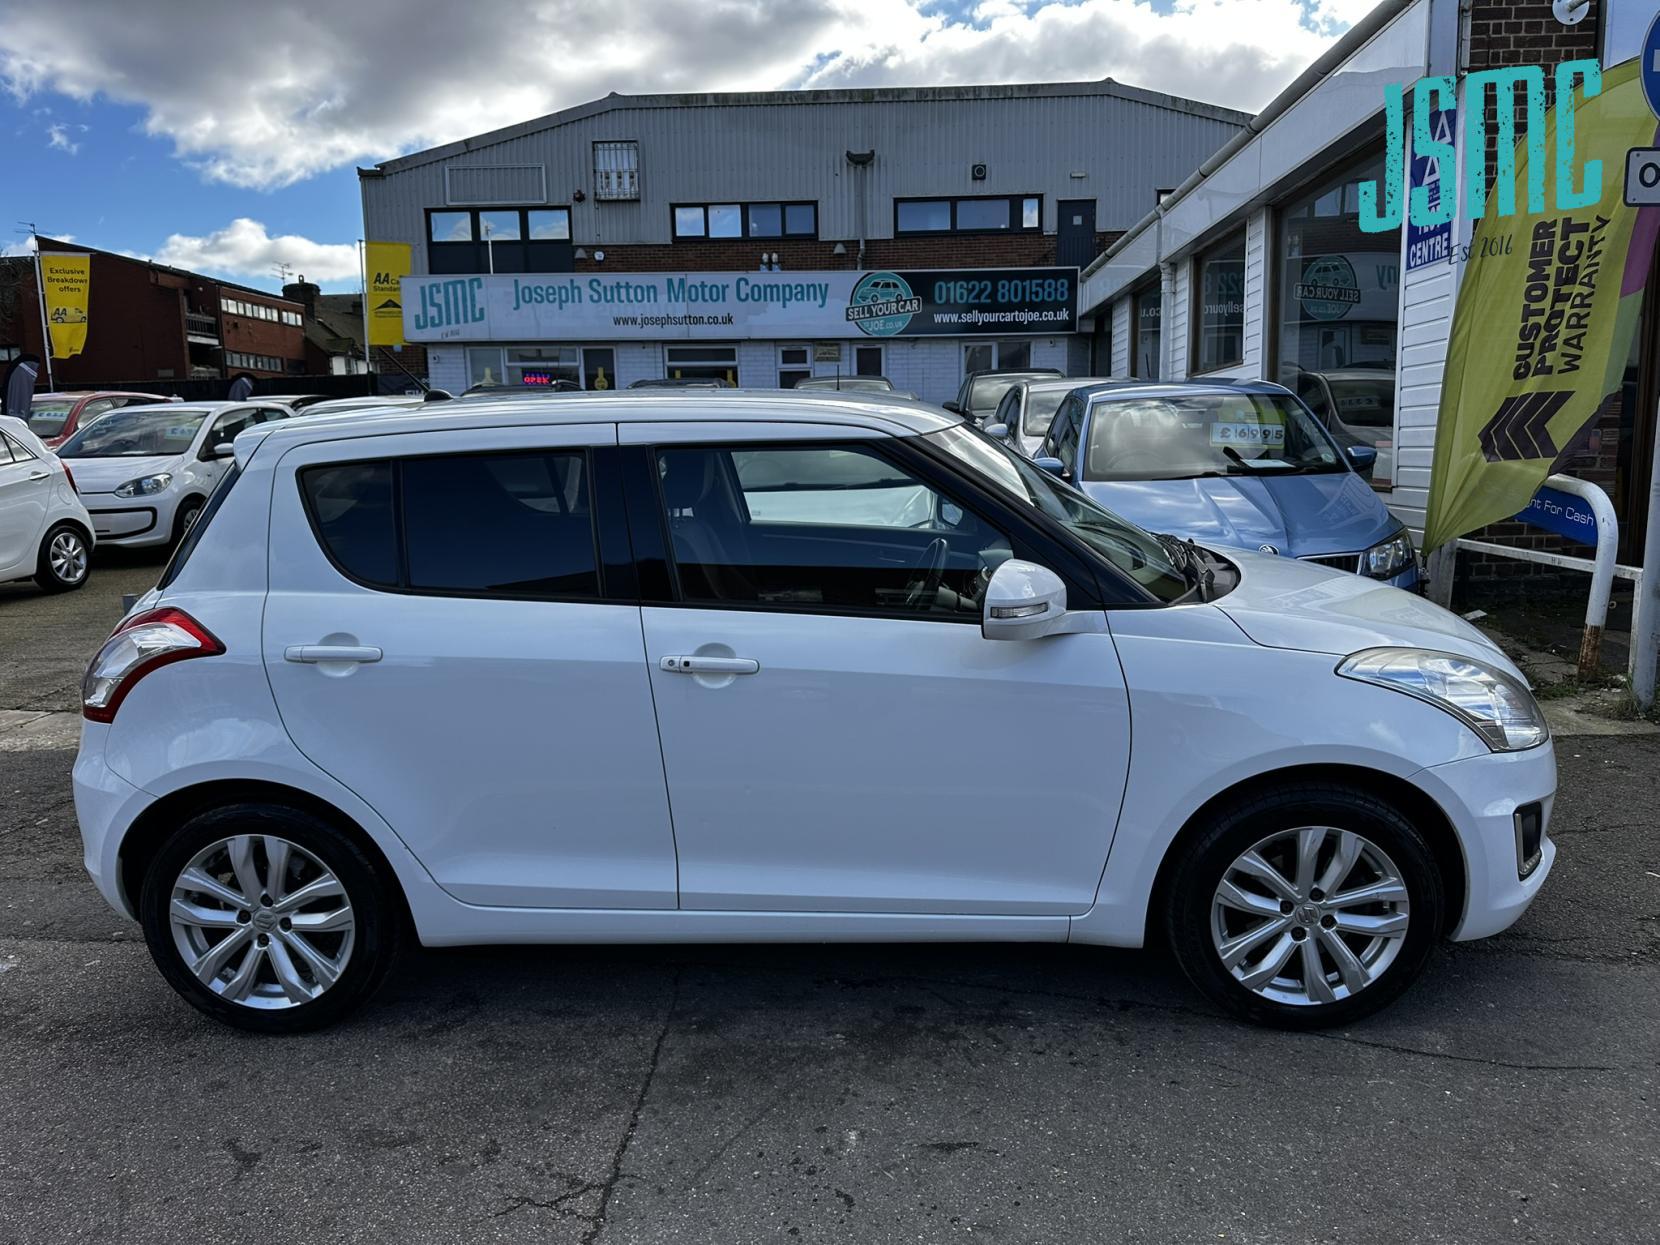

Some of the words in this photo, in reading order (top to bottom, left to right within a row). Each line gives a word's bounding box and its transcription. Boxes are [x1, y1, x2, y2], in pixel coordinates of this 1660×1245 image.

[1409, 231, 1450, 268] CENTRE
[49, 267, 85, 275] Exclusive
[374, 272, 389, 284] AA
[414, 277, 485, 330] JSMC
[513, 278, 582, 311] Joseph
[589, 278, 658, 304] Sutton
[666, 277, 729, 303] Motor
[735, 277, 829, 309] Company
[934, 281, 992, 304] 01622
[997, 279, 1069, 303] 801588
[1513, 218, 1558, 381] CUSTOMER
[1531, 216, 1590, 378] PROTECT
[1557, 214, 1611, 375] WARRANTY
[54, 307, 67, 316] AA
[613, 312, 734, 328] www.josephsutton.co.uk
[848, 306, 870, 320] SELL
[870, 303, 897, 316] YOUR
[898, 301, 919, 313] CAR
[933, 307, 1069, 325] www.sellyourcartojoe.co.uk
[1544, 500, 1563, 515] For
[1565, 506, 1594, 526] Cash
